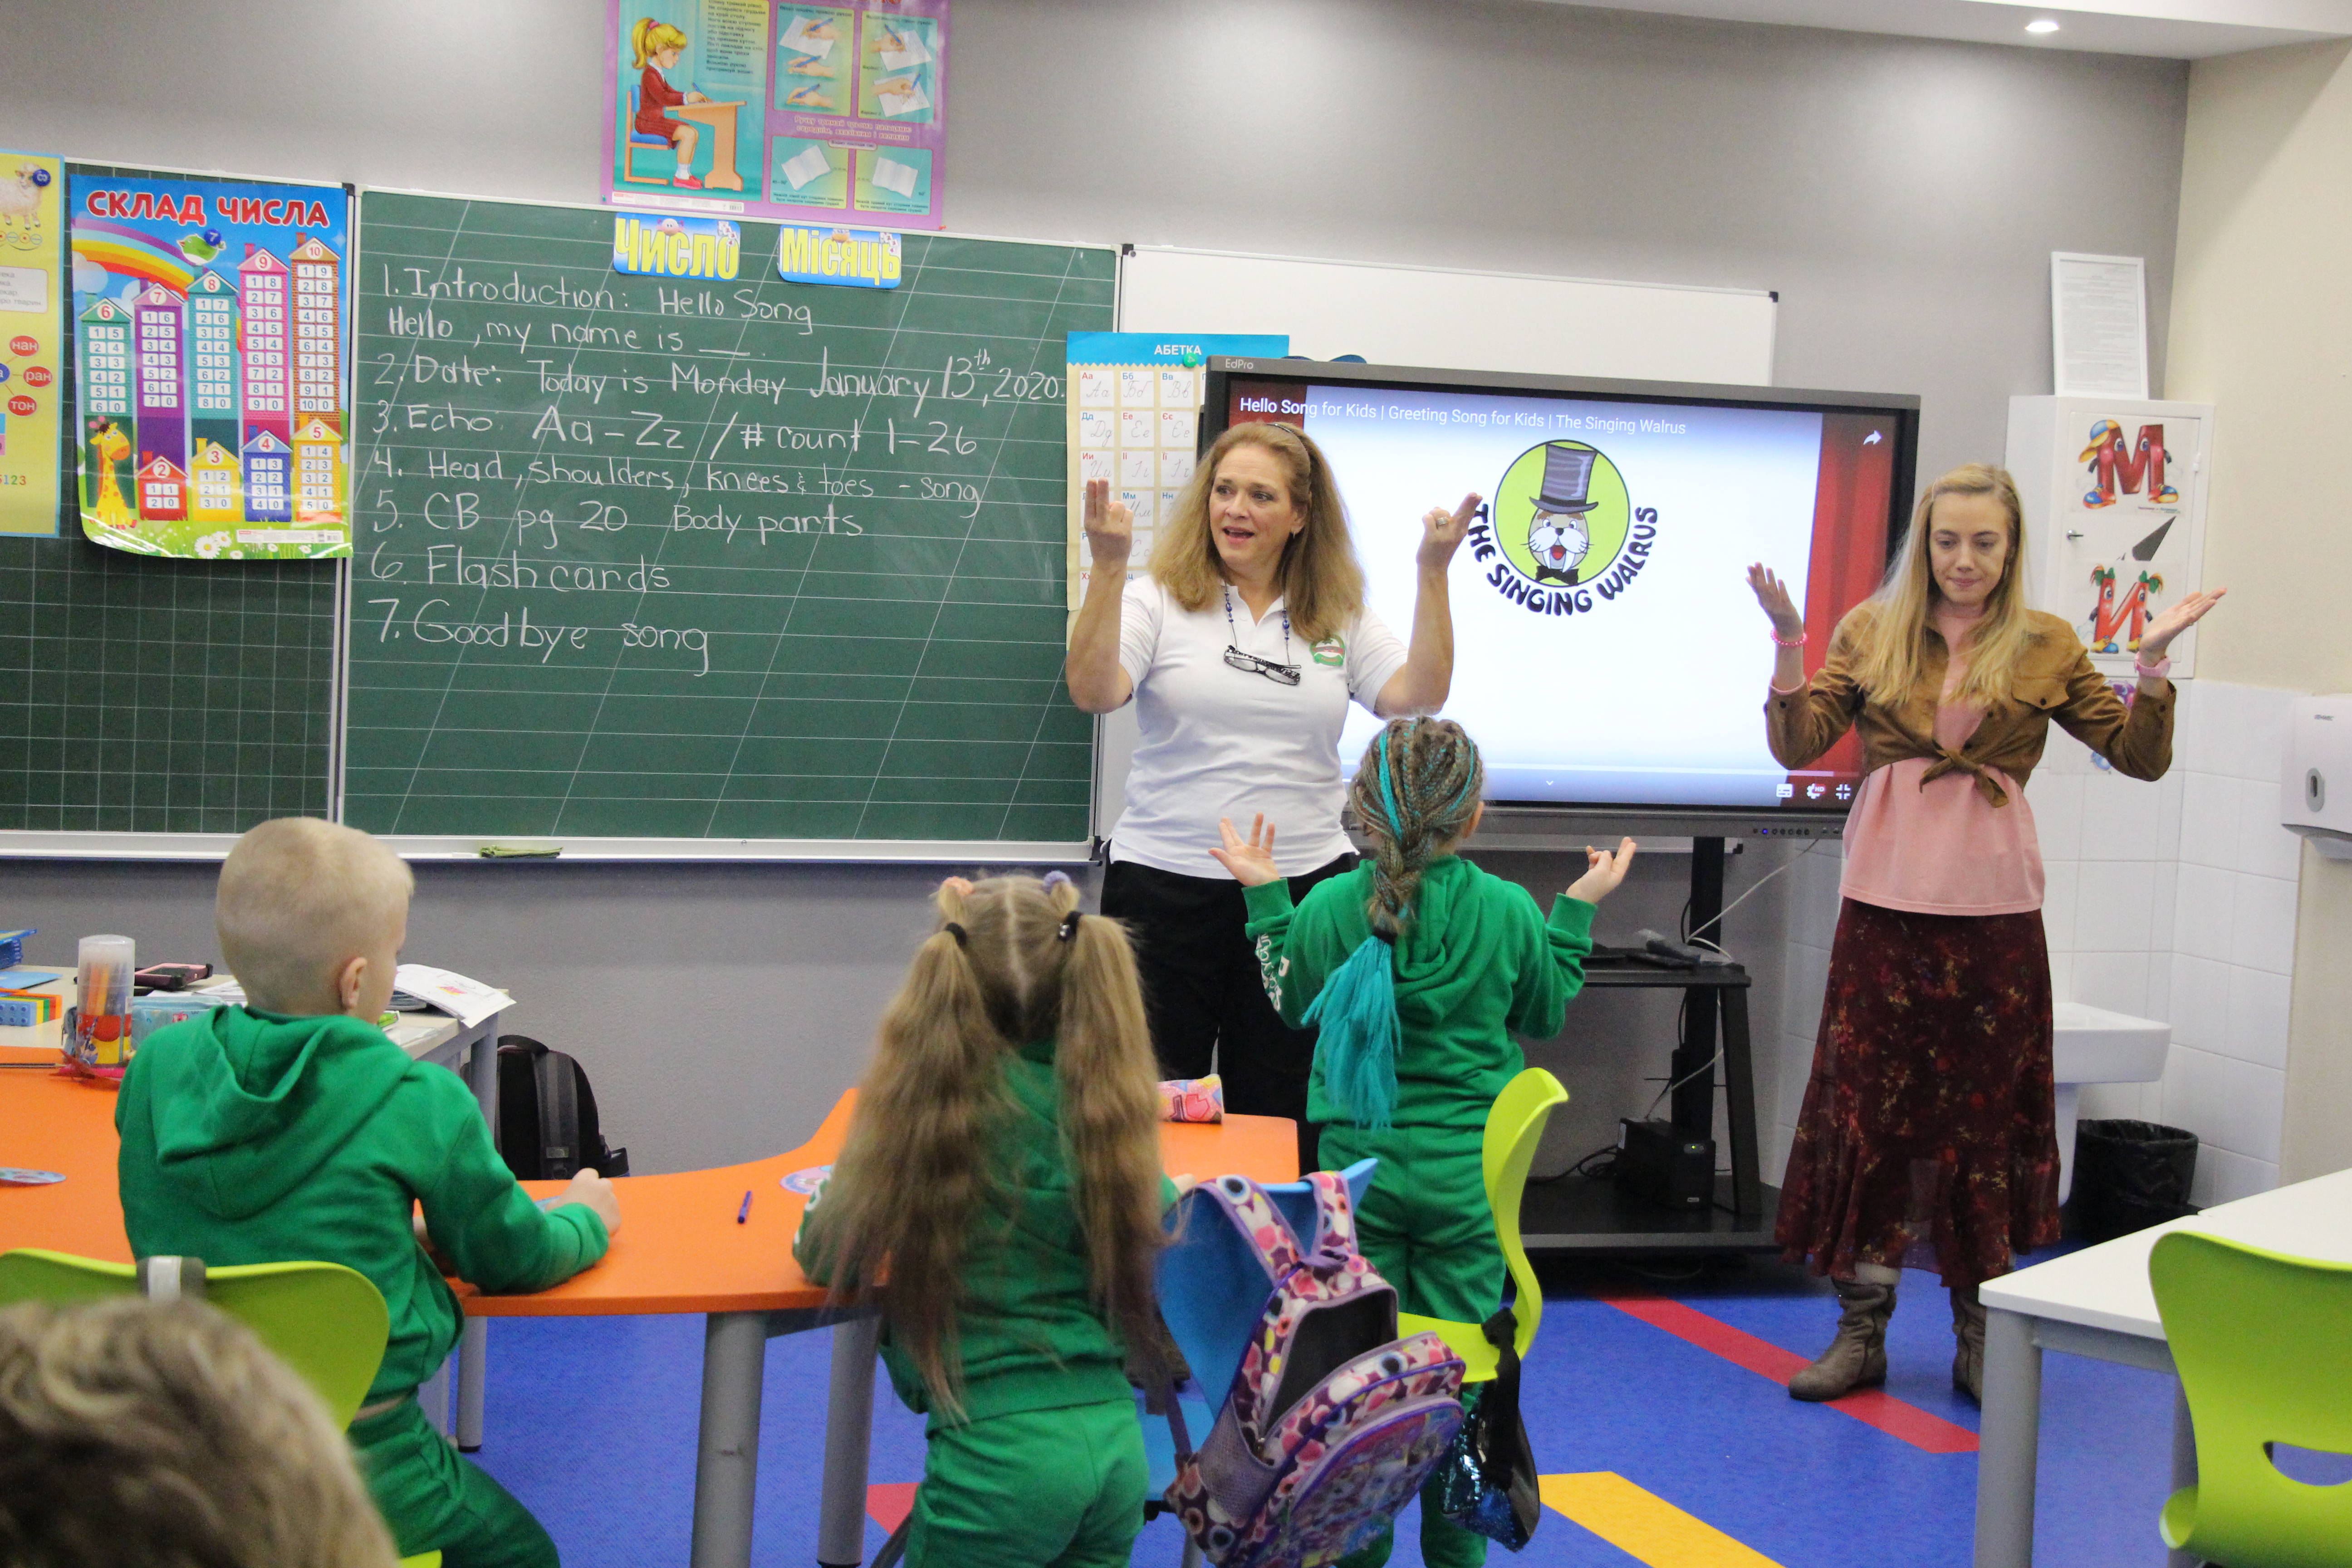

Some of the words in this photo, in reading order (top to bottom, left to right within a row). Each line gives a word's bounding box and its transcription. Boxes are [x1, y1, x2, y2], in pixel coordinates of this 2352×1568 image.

[87, 191, 206, 226] СКЛАД
[217, 197, 330, 228] ЧИСЛА
[209, 232, 218, 242] 7
[309, 246, 320, 256] 10
[615, 217, 739, 280] Число
[782, 227, 901, 286] Місяць
[259, 256, 268, 269] 9
[303, 266, 308, 275] 1
[320, 267, 327, 276] 9
[208, 279, 216, 290] 8
[303, 282, 309, 291] 2
[321, 282, 328, 291] 8
[155, 292, 162, 303] 7
[303, 296, 309, 306] 3
[321, 297, 328, 306] 7
[101, 305, 111, 319] 6
[659, 287, 724, 317] Hello
[733, 288, 813, 335] Song
[304, 312, 310, 320] 4
[321, 312, 328, 322] 6
[304, 327, 310, 337] 5
[322, 327, 328, 337] 5
[552, 323, 642, 350] name
[658, 326, 683, 352] is
[12, 341, 38, 351] нан
[304, 341, 310, 351] 6
[322, 342, 328, 351] 4
[1154, 344, 1202, 356] АБЕТКА
[304, 356, 310, 365] 7
[323, 356, 329, 366] 3
[1225, 359, 1254, 370] EdPro
[26, 371, 52, 382] ран
[304, 371, 311, 380] 8
[322, 371, 328, 381] 2
[526, 359, 607, 404] Today
[622, 369, 649, 393] is
[671, 362, 786, 405] Monday
[809, 346, 930, 418] January
[304, 386, 311, 396] 9
[323, 386, 328, 395] 1
[10, 401, 35, 411] тон
[302, 400, 314, 409] 10
[322, 400, 329, 410] 0
[1240, 397, 1278, 413] Hello
[1280, 399, 1318, 418] Song
[1321, 401, 1342, 416] for
[1346, 403, 1377, 418] Kids
[1388, 406, 1448, 425] Greeting
[1451, 409, 1487, 427] Song
[1490, 411, 1511, 426] for
[1514, 412, 1544, 427] Kids
[1555, 414, 1582, 429] The
[1585, 416, 1636, 435] Singing
[1639, 419, 1686, 434] Walrus
[314, 426, 322, 439] 5
[777, 419, 861, 452] count
[261, 438, 270, 450] 4
[211, 451, 220, 463] 3
[158, 464, 166, 477] 2
[818, 463, 874, 498] toes
[424, 492, 480, 530] CB
[517, 508, 558, 549] pg
[579, 500, 628, 531] 20
[673, 504, 741, 544] Body
[758, 503, 863, 546] parts
[1468, 504, 1496, 563] THE
[1486, 563, 1592, 616] SINGING
[1596, 506, 1658, 600] WALRUS
[621, 622, 709, 677] song
